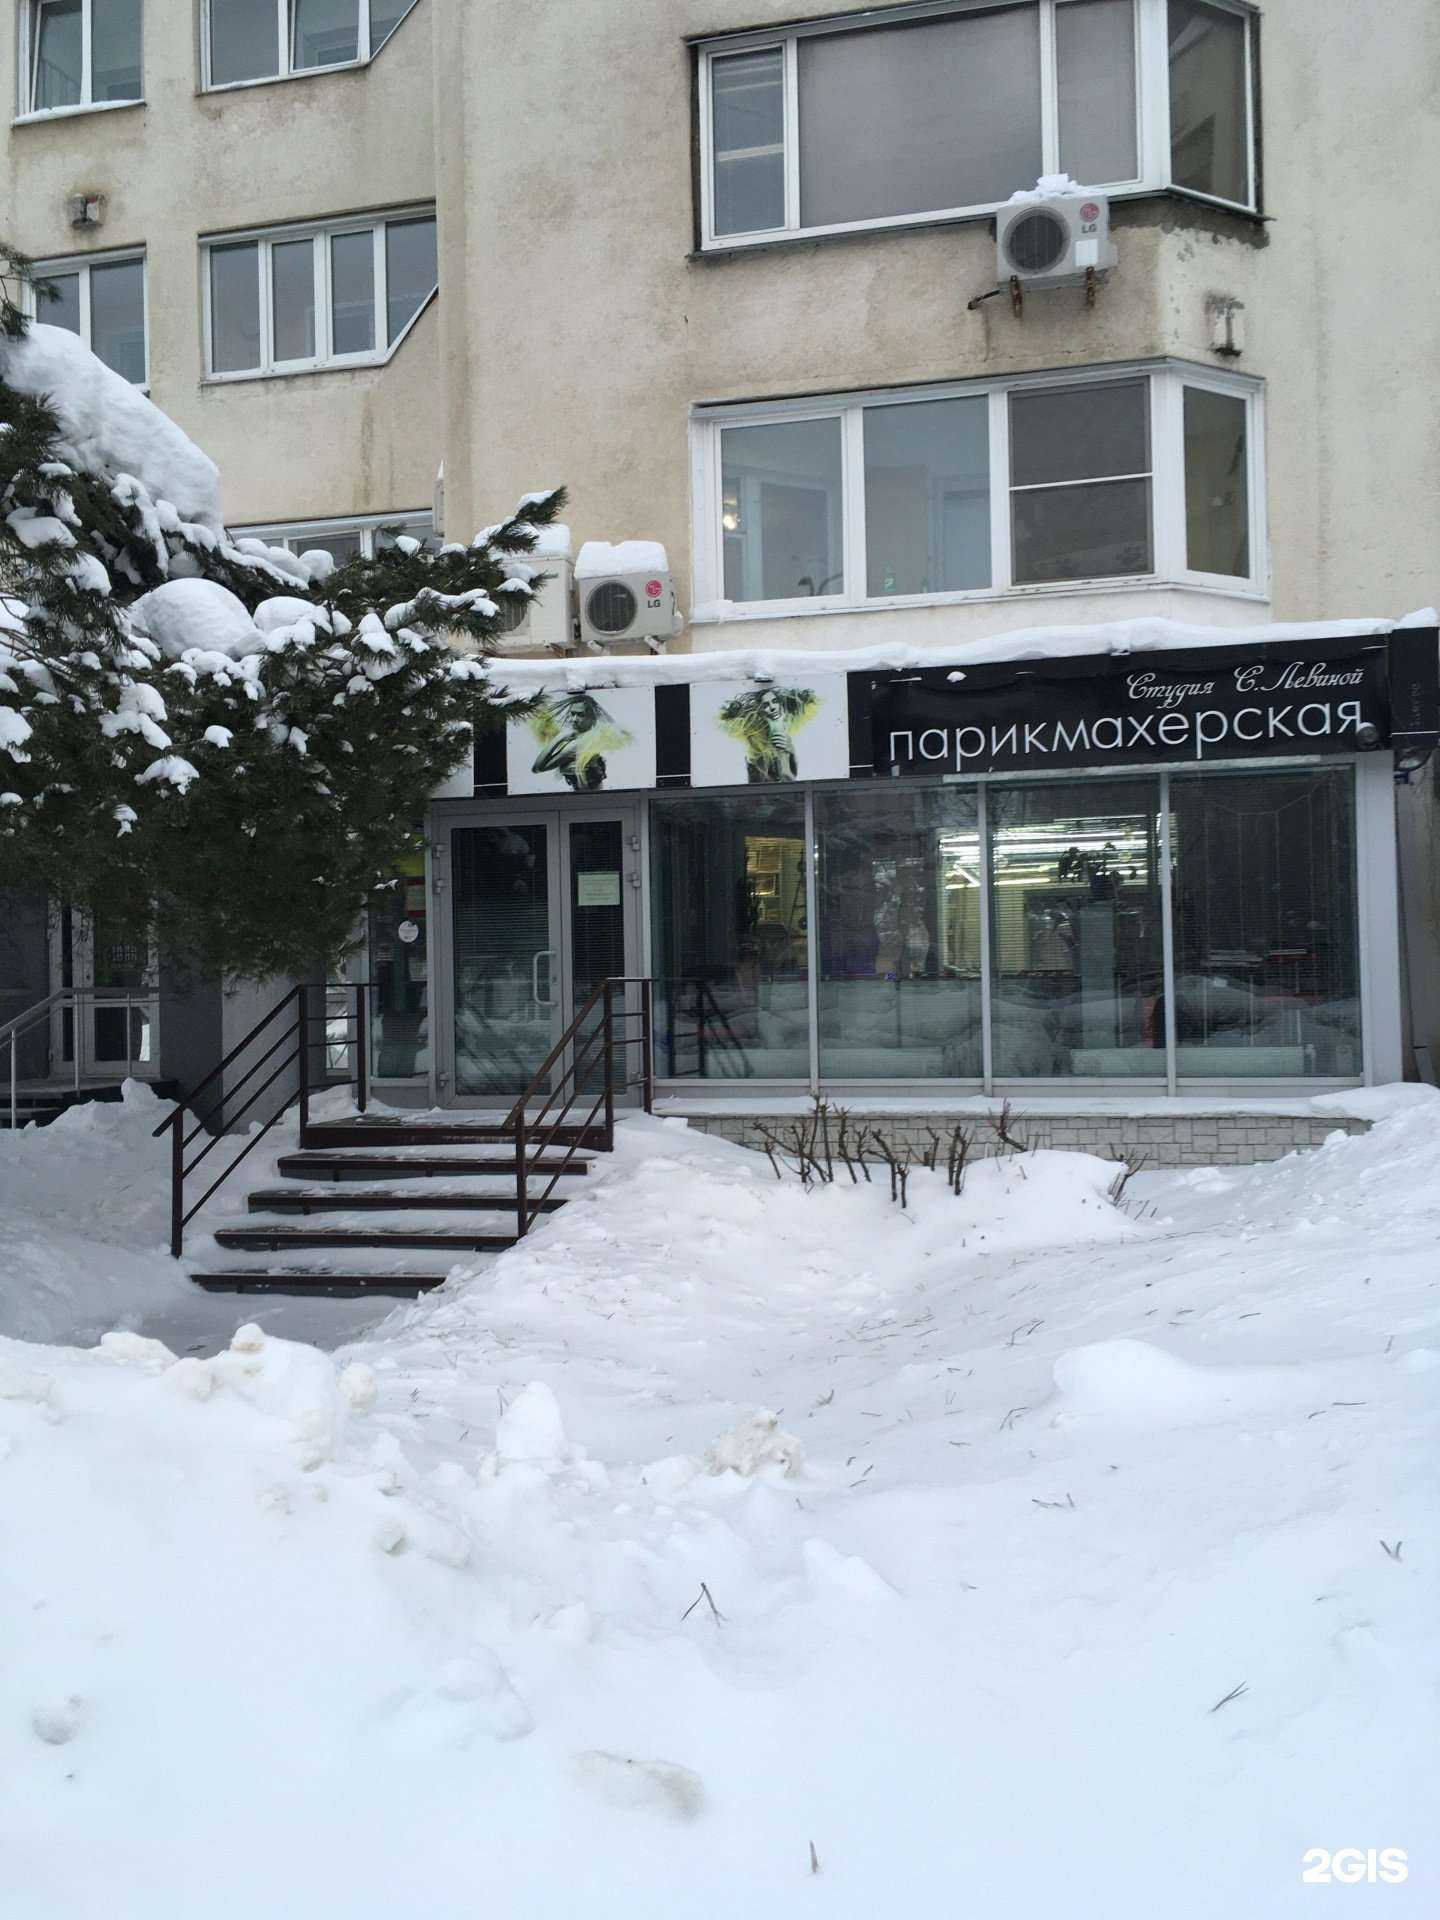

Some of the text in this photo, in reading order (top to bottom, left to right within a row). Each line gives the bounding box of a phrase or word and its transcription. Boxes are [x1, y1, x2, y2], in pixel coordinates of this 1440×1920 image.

[1082, 223, 1097, 234] LG
[647, 599, 661, 609] LG
[1126, 672, 1216, 709] Студия
[888, 700, 1363, 772] парикмахерская
